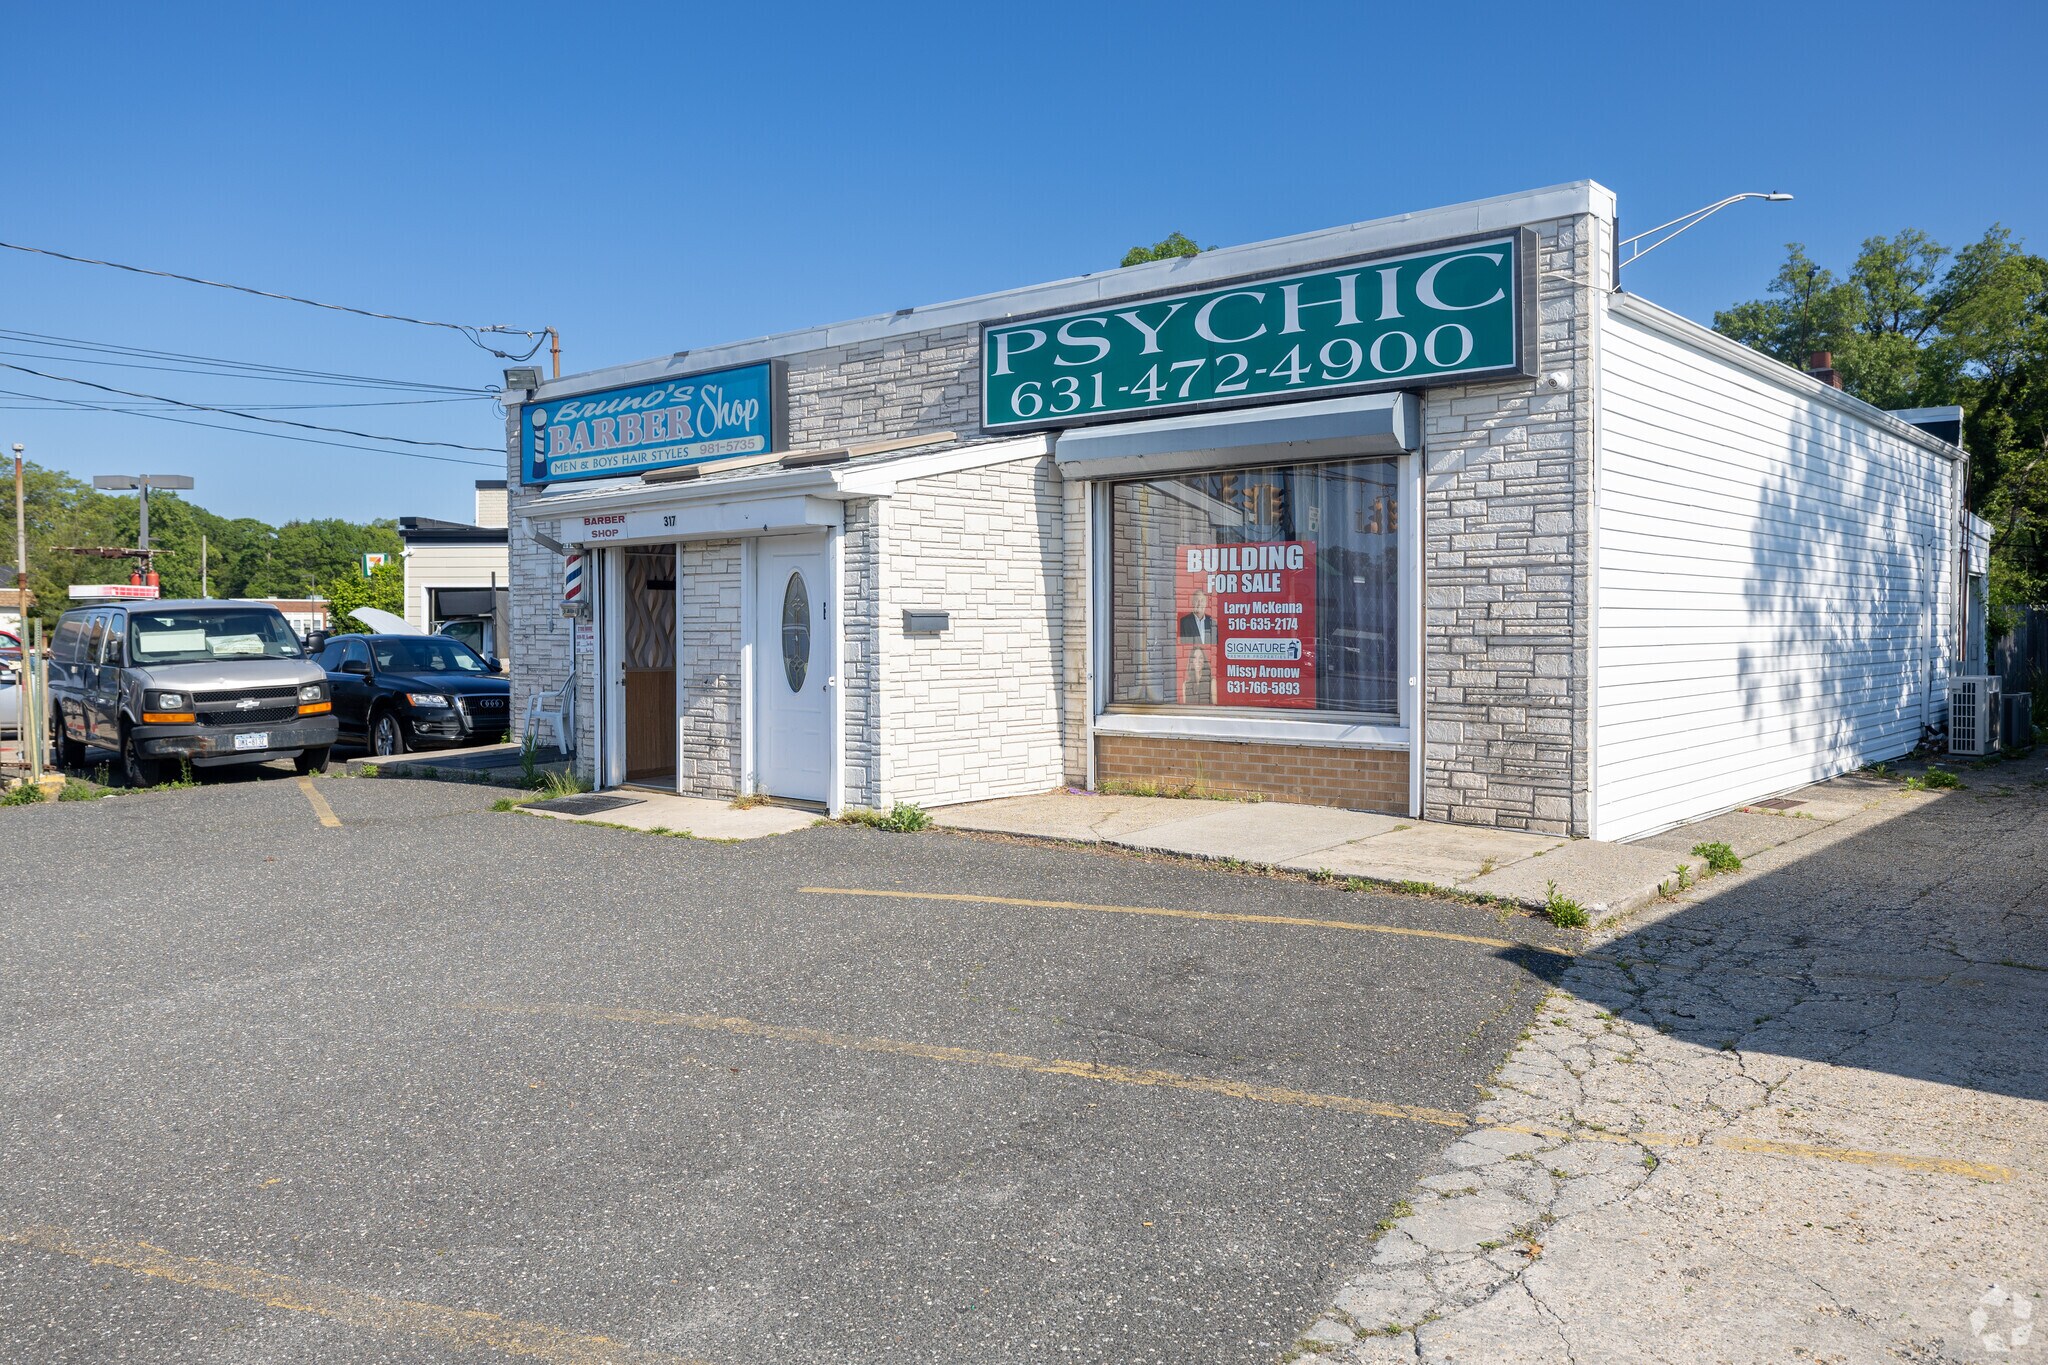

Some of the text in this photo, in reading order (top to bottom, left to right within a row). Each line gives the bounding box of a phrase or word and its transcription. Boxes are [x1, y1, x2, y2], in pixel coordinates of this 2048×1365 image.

[991, 252, 1506, 377] PSYCHIC
[1010, 323, 1474, 417] 631-472-4900
[548, 384, 759, 457] BARBER Shop
[554, 438, 755, 473] MEN & BOYS HAIR STYLES 981-5735
[584, 515, 625, 526] BARBER
[663, 515, 676, 527] 317
[591, 529, 619, 538] SHOP
[1187, 544, 1304, 573] BUILDING
[1207, 572, 1281, 594] FOR SALE
[1224, 601, 1303, 615] Larry McKenna
[1228, 617, 1298, 631] 516-635-2174
[1226, 642, 1286, 653] SIGNATURE
[1226, 664, 1300, 679] Missy Aronow
[1226, 680, 1300, 695] 631-766-5893
